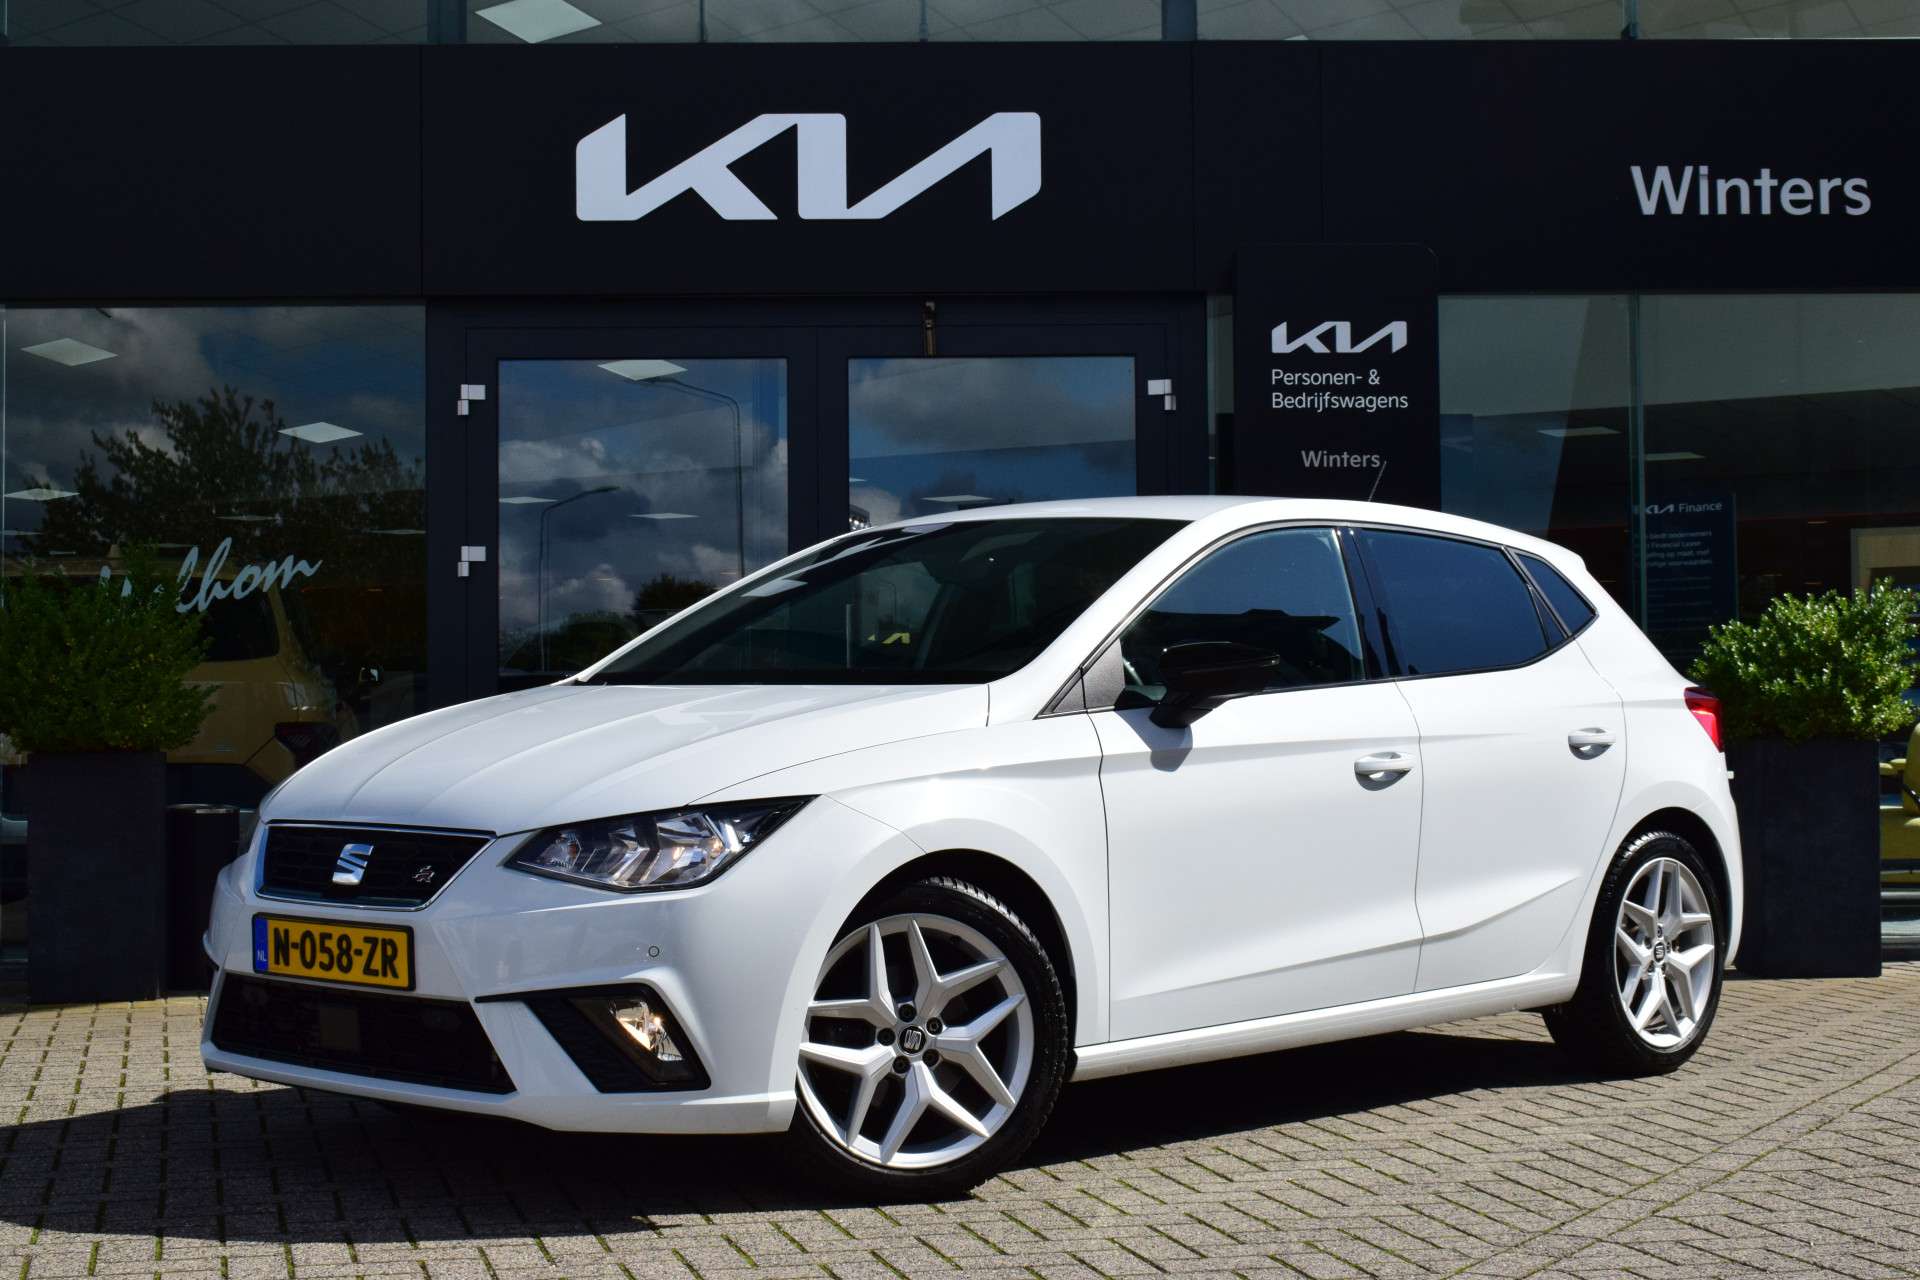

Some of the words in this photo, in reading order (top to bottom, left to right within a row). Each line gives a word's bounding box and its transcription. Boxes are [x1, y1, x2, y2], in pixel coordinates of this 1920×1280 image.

[576, 112, 1042, 221] KIA
[1630, 165, 1872, 216] Winters
[1271, 321, 1408, 353] KIA
[1271, 369, 1363, 386] Personen-
[1368, 369, 1381, 386] &
[1271, 392, 1409, 412] Bedrijfswagens
[1301, 450, 1381, 469] Winters
[1679, 502, 1723, 513] Finance
[256, 949, 268, 962] NL
[273, 927, 400, 979] N-058-ZR
